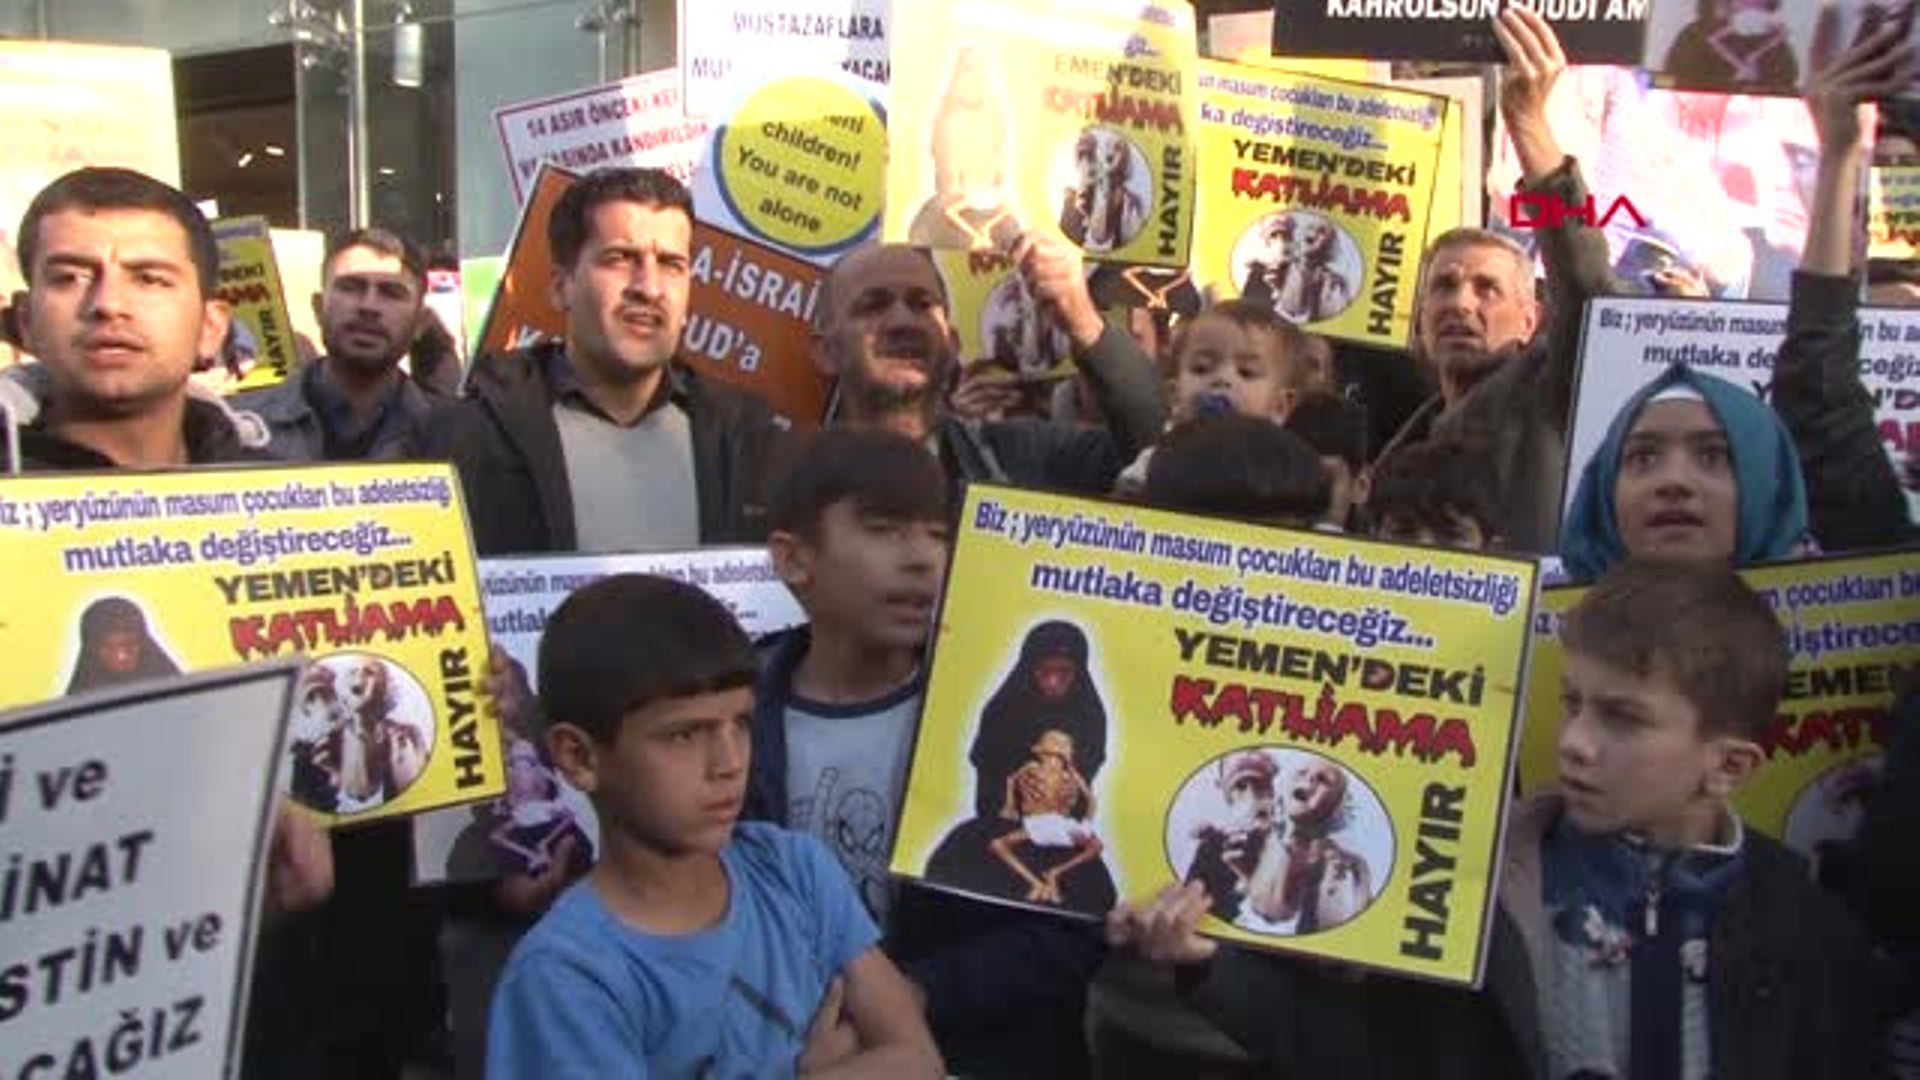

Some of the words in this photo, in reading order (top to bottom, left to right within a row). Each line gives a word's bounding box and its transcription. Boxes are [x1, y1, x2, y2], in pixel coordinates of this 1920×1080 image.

[1604, 0, 1646, 20] AM
[527, 119, 547, 139] 14
[549, 109, 586, 131] ASIR
[1201, 102, 1225, 122] ka
[1336, 92, 1356, 112] bu
[762, 121, 861, 171] children!
[1233, 138, 1416, 186] YEMEN'DEKİ
[739, 146, 779, 178] You
[783, 169, 820, 194] are
[824, 188, 863, 212] not
[1158, 145, 1182, 256] HAYIR
[1231, 167, 1412, 223] KATLİAMA
[759, 199, 822, 232] alone
[692, 247, 820, 322] A-İSRAİ
[1367, 231, 1405, 335] HAYIR
[684, 313, 762, 373] UD'a
[1599, 307, 1623, 329] Biz
[1633, 309, 1727, 336] yeryüzünün
[1877, 318, 1901, 342] bu
[1642, 343, 1740, 368] mutlaka
[1746, 347, 1778, 369] de
[37, 489, 161, 532] yeryüzünün
[165, 493, 239, 518] masum
[330, 477, 355, 505] bu
[63, 536, 194, 571] mutlaka
[199, 520, 412, 566] değiştireceğiz...
[974, 501, 1006, 531] Biz
[1021, 511, 1147, 553] yeryüzünün
[1149, 531, 1232, 566] masum
[1237, 547, 1341, 580] çocukları
[1345, 554, 1376, 587] bu
[1379, 563, 1520, 616] adeletsizliği
[215, 550, 456, 606] YEMEN'DEKİ
[484, 570, 546, 596] üzünün
[1030, 563, 1163, 606] mutlaka
[1171, 579, 1434, 648] değiştireceğiz...
[229, 593, 466, 662] KATLİAMA
[1174, 627, 1485, 707] YEMEN'DEKİ
[438, 646, 485, 791] HAYIR
[1170, 673, 1477, 770] KATLİAMA
[37, 760, 107, 811] ve
[1400, 781, 1467, 962] HAYIR
[0, 927, 144, 1024] STİN
[164, 912, 223, 961] ve
[17, 993, 204, 1080] CAĞIZ
